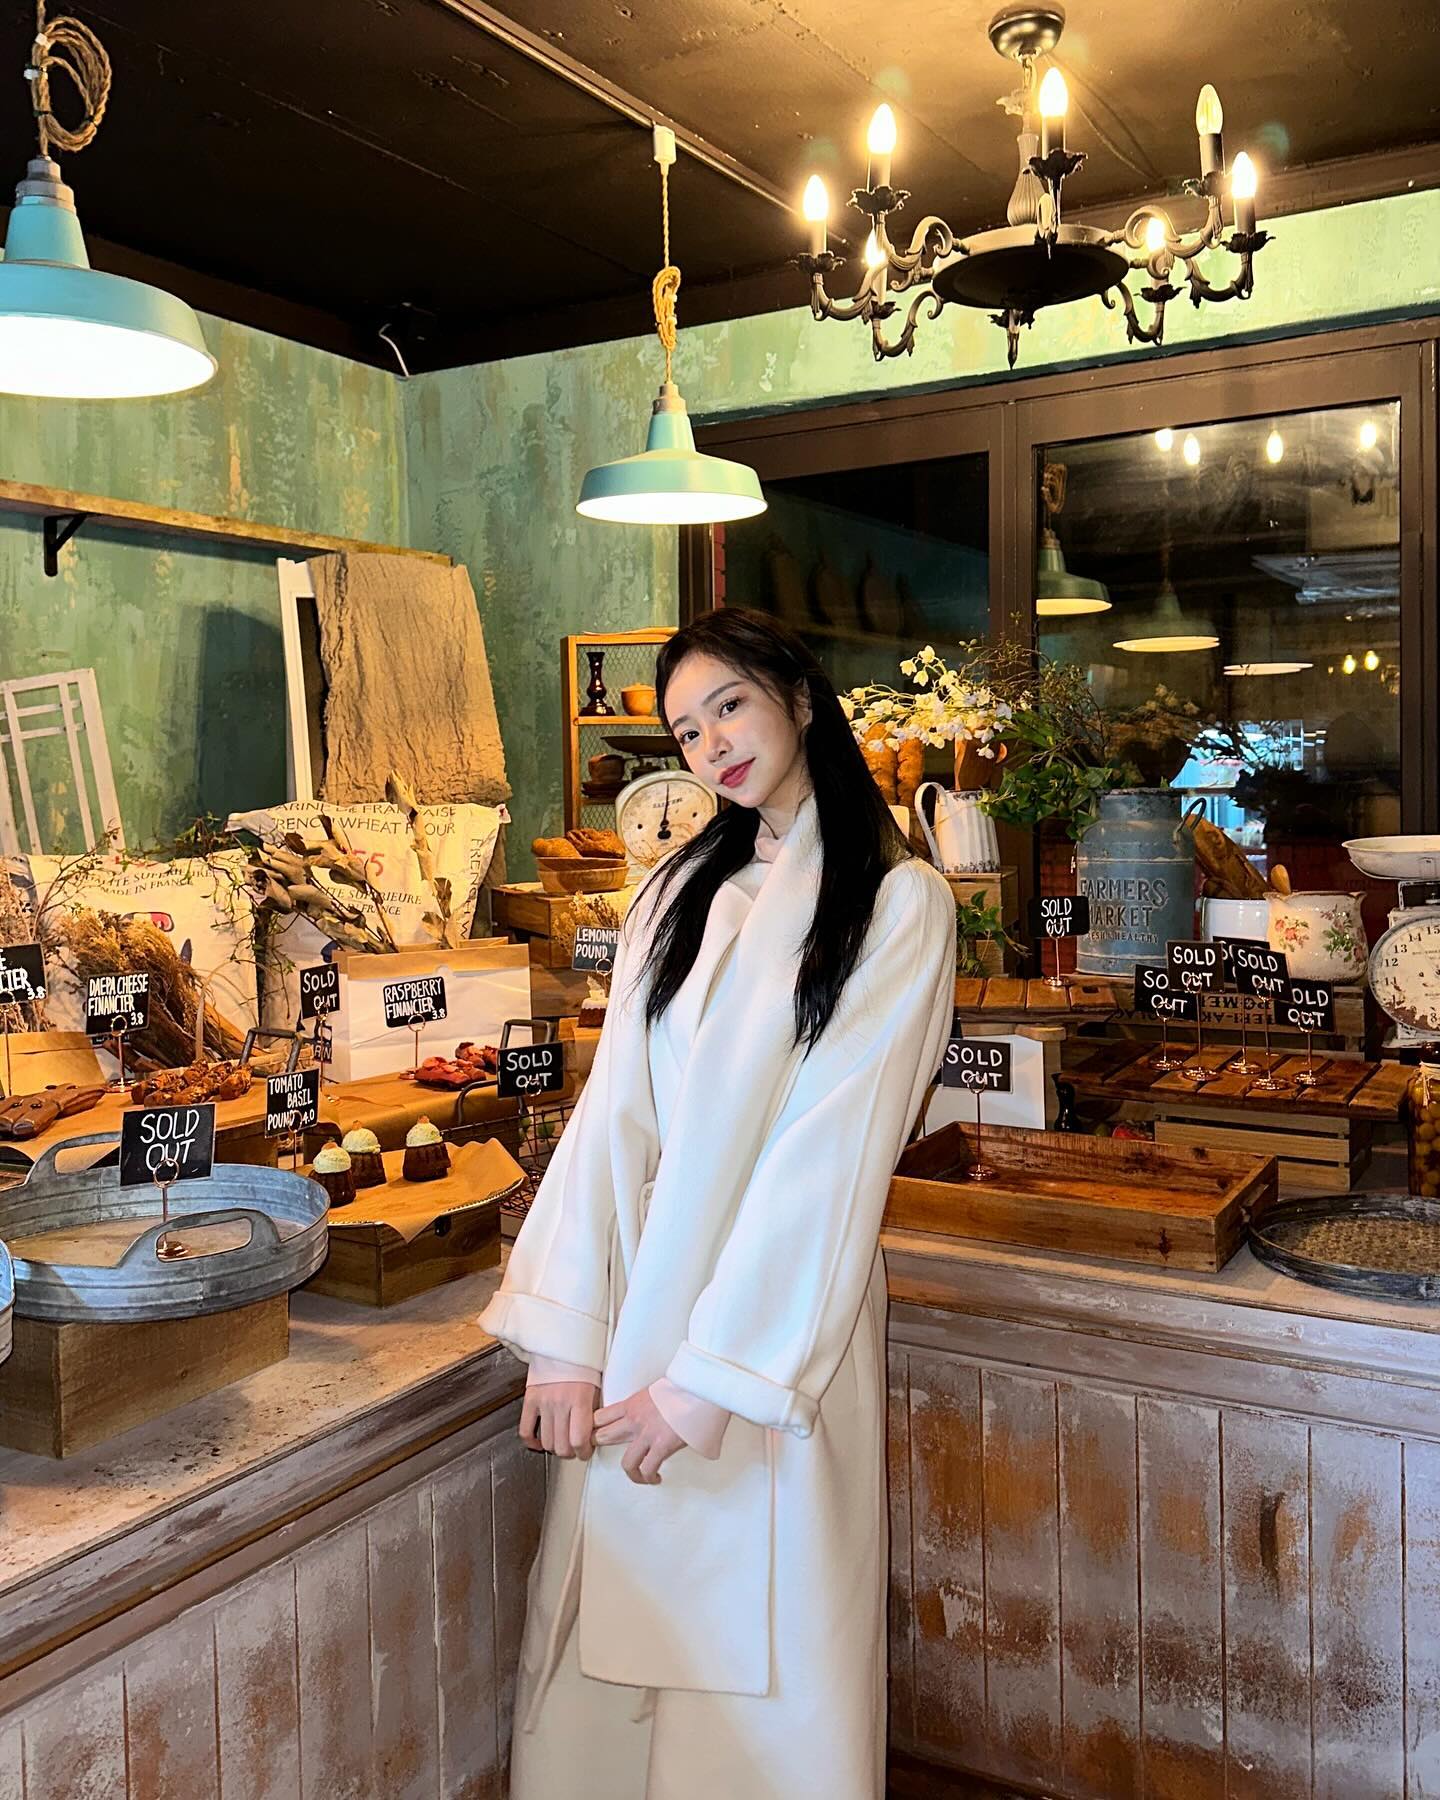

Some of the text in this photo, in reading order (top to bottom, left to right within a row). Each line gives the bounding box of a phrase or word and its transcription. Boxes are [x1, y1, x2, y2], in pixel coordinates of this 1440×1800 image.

[339, 817, 402, 834] WHEAT
[404, 821, 456, 837] FOUR
[348, 885, 422, 905] SUPRIEURE
[361, 903, 402, 916] FRNCE
[1041, 897, 1073, 918] SOLD
[1046, 916, 1073, 935] OUT
[575, 943, 609, 960] POUND
[1172, 945, 1216, 967] SOLD
[1393, 944, 1408, 954] 13
[1237, 949, 1279, 973] SOLD
[1384, 957, 1399, 967] 12
[89, 973, 149, 997] DAEPA CHEESE
[302, 970, 336, 994] SOLD
[1181, 971, 1214, 988] OUT
[1251, 974, 1285, 993] OUT
[26, 985, 46, 1000] 3.8
[384, 978, 442, 1003] RASPBERRY
[1291, 988, 1329, 1007] OLD
[87, 994, 135, 1017] FINANCIER
[313, 993, 338, 1011] OUT
[385, 996, 446, 1020] FINANCIER 3.8
[1151, 994, 1188, 1014] OUT
[130, 1011, 145, 1026] 3.8
[1287, 1008, 1326, 1028] OUT
[506, 1050, 553, 1072] SOLD
[945, 1044, 1003, 1067] SOLD
[268, 1073, 304, 1096] TOMATO
[515, 1072, 553, 1089] OUT
[961, 1069, 1004, 1088] OUT
[287, 1088, 314, 1109] BASIL
[140, 1109, 200, 1144] SOLD
[267, 1108, 315, 1132] POUND 4.0
[145, 1138, 196, 1172] OUT
